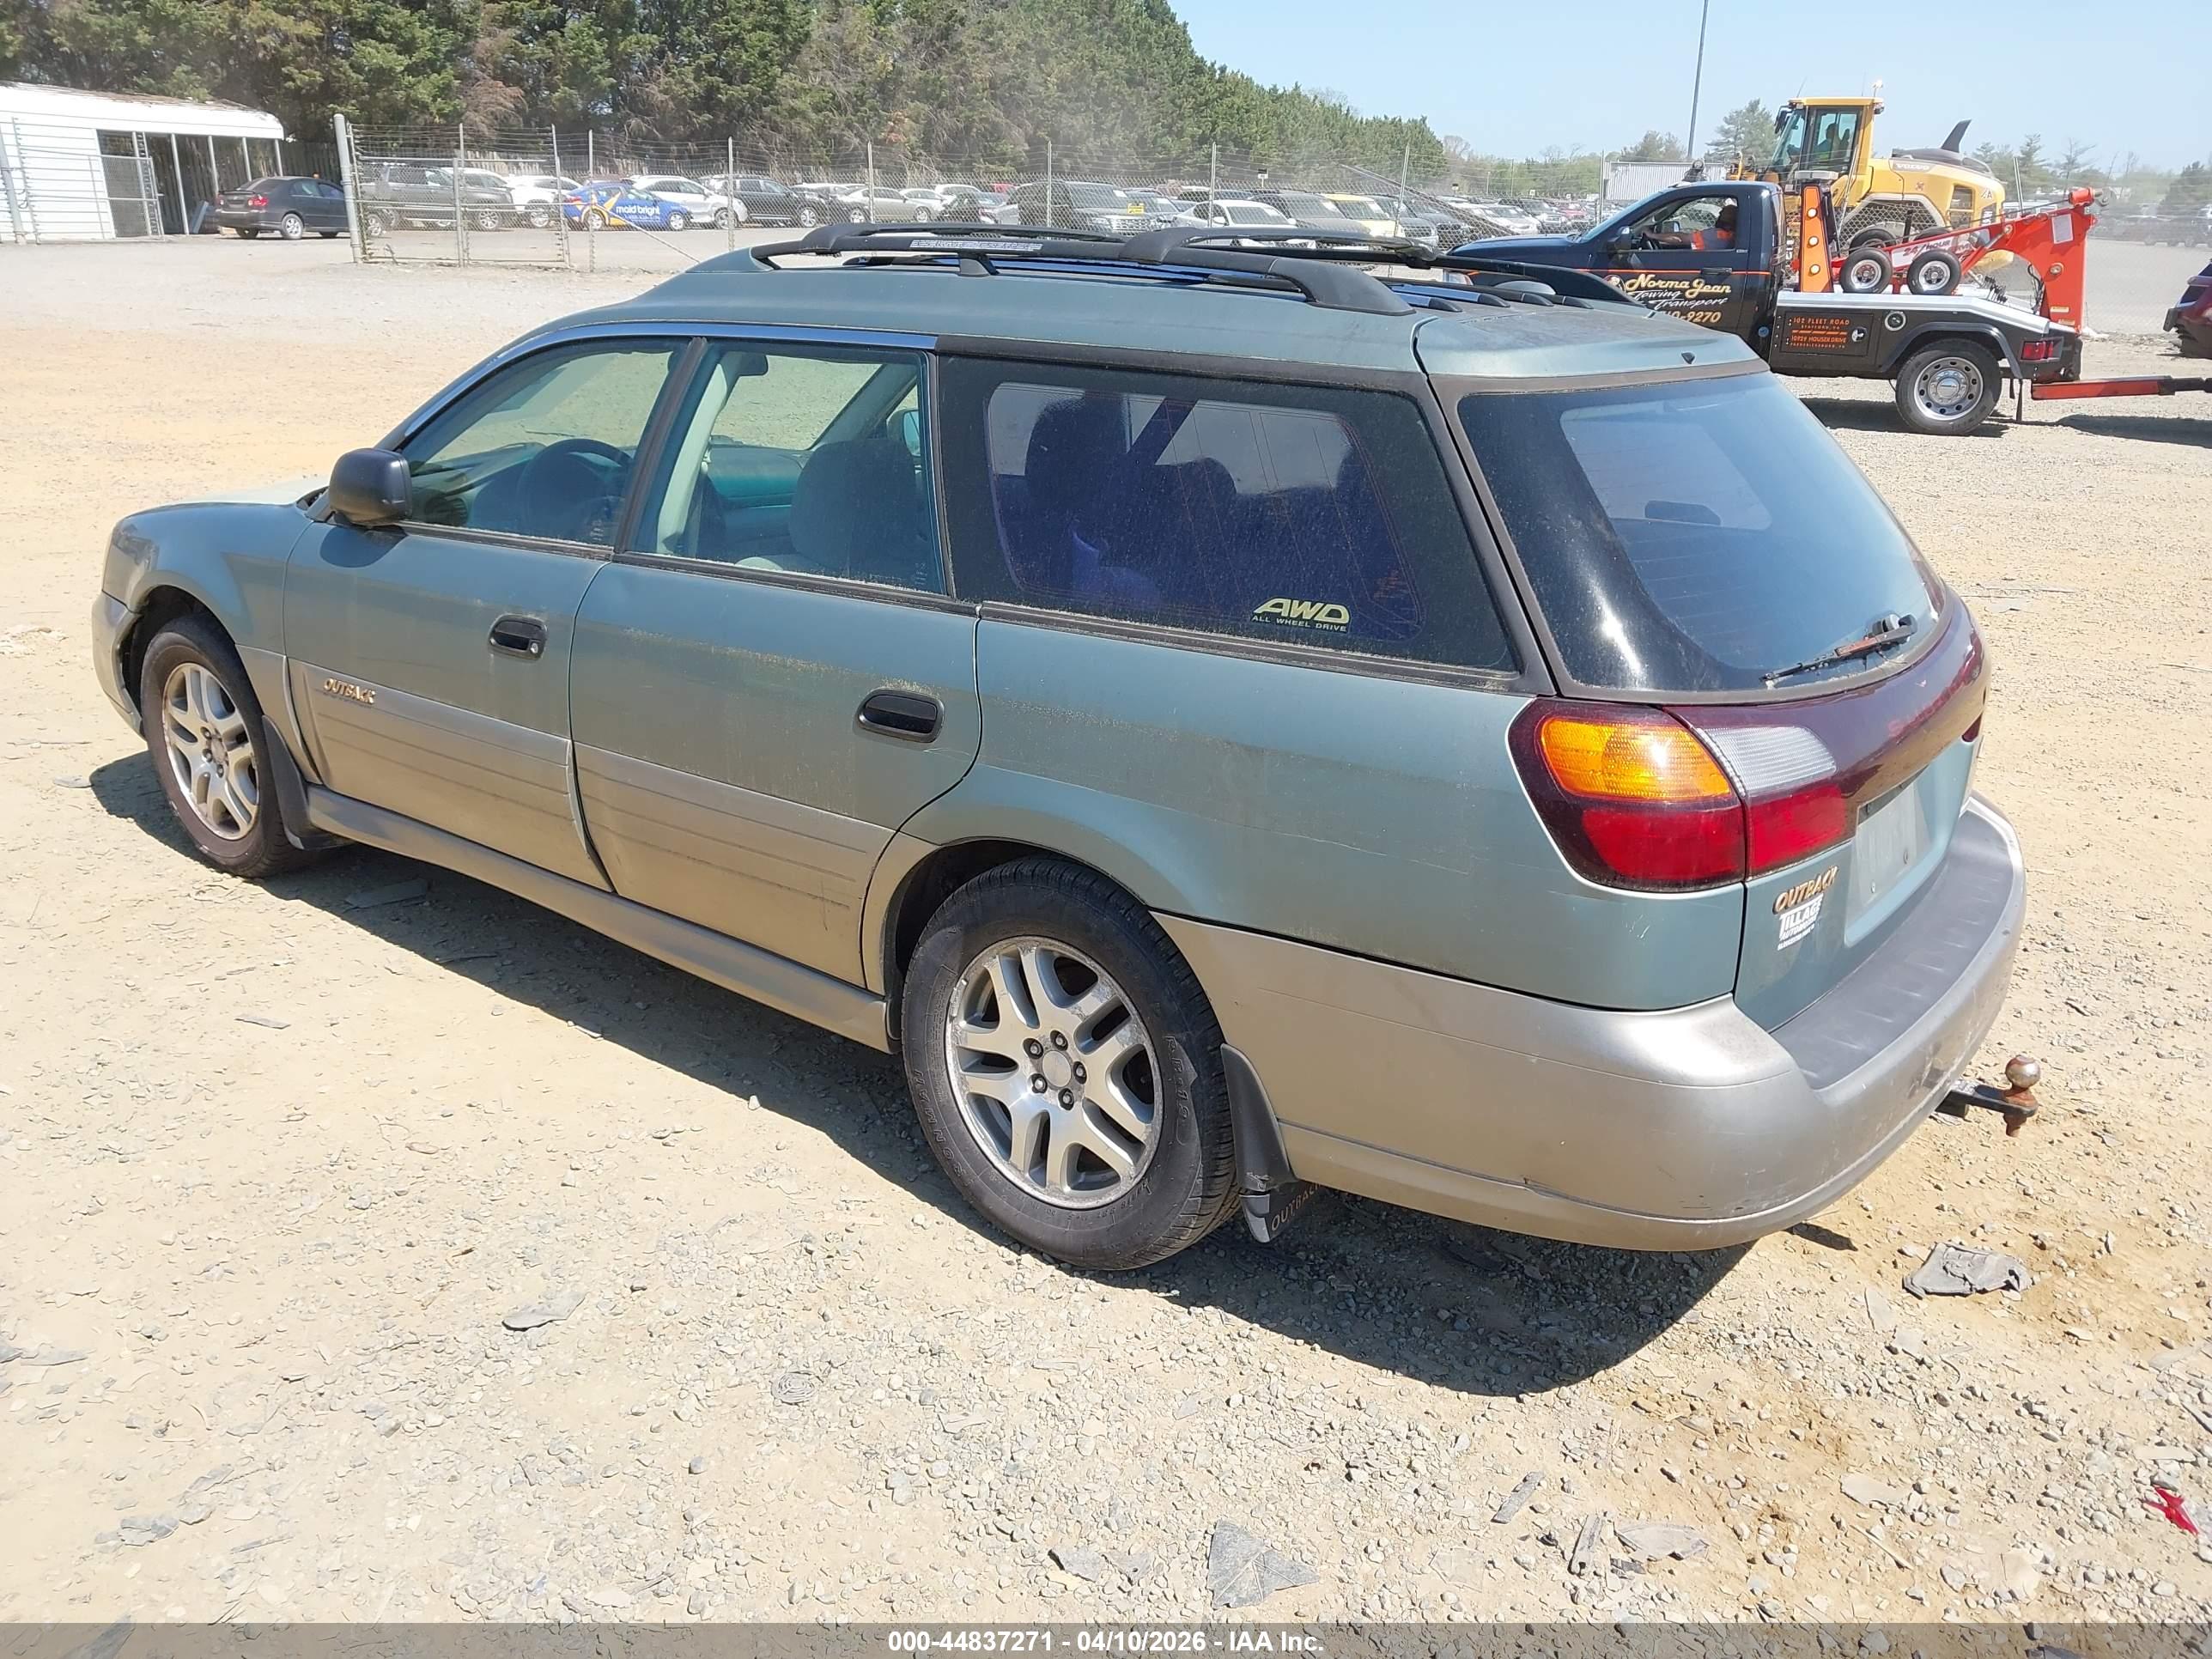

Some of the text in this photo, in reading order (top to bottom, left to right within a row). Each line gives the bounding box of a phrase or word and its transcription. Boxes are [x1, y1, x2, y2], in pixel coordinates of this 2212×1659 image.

[616, 205, 660, 216] maid bright
[1625, 274, 1732, 298] Norma Jean
[1627, 289, 1684, 300] Towing
[1649, 297, 1729, 310] Transport
[1253, 598, 1350, 624] AWD
[1276, 618, 1311, 628] WHEEL
[1316, 623, 1347, 632] DRIVE
[324, 678, 376, 704] OUTBACK
[1772, 866, 1839, 914] OUTBACK
